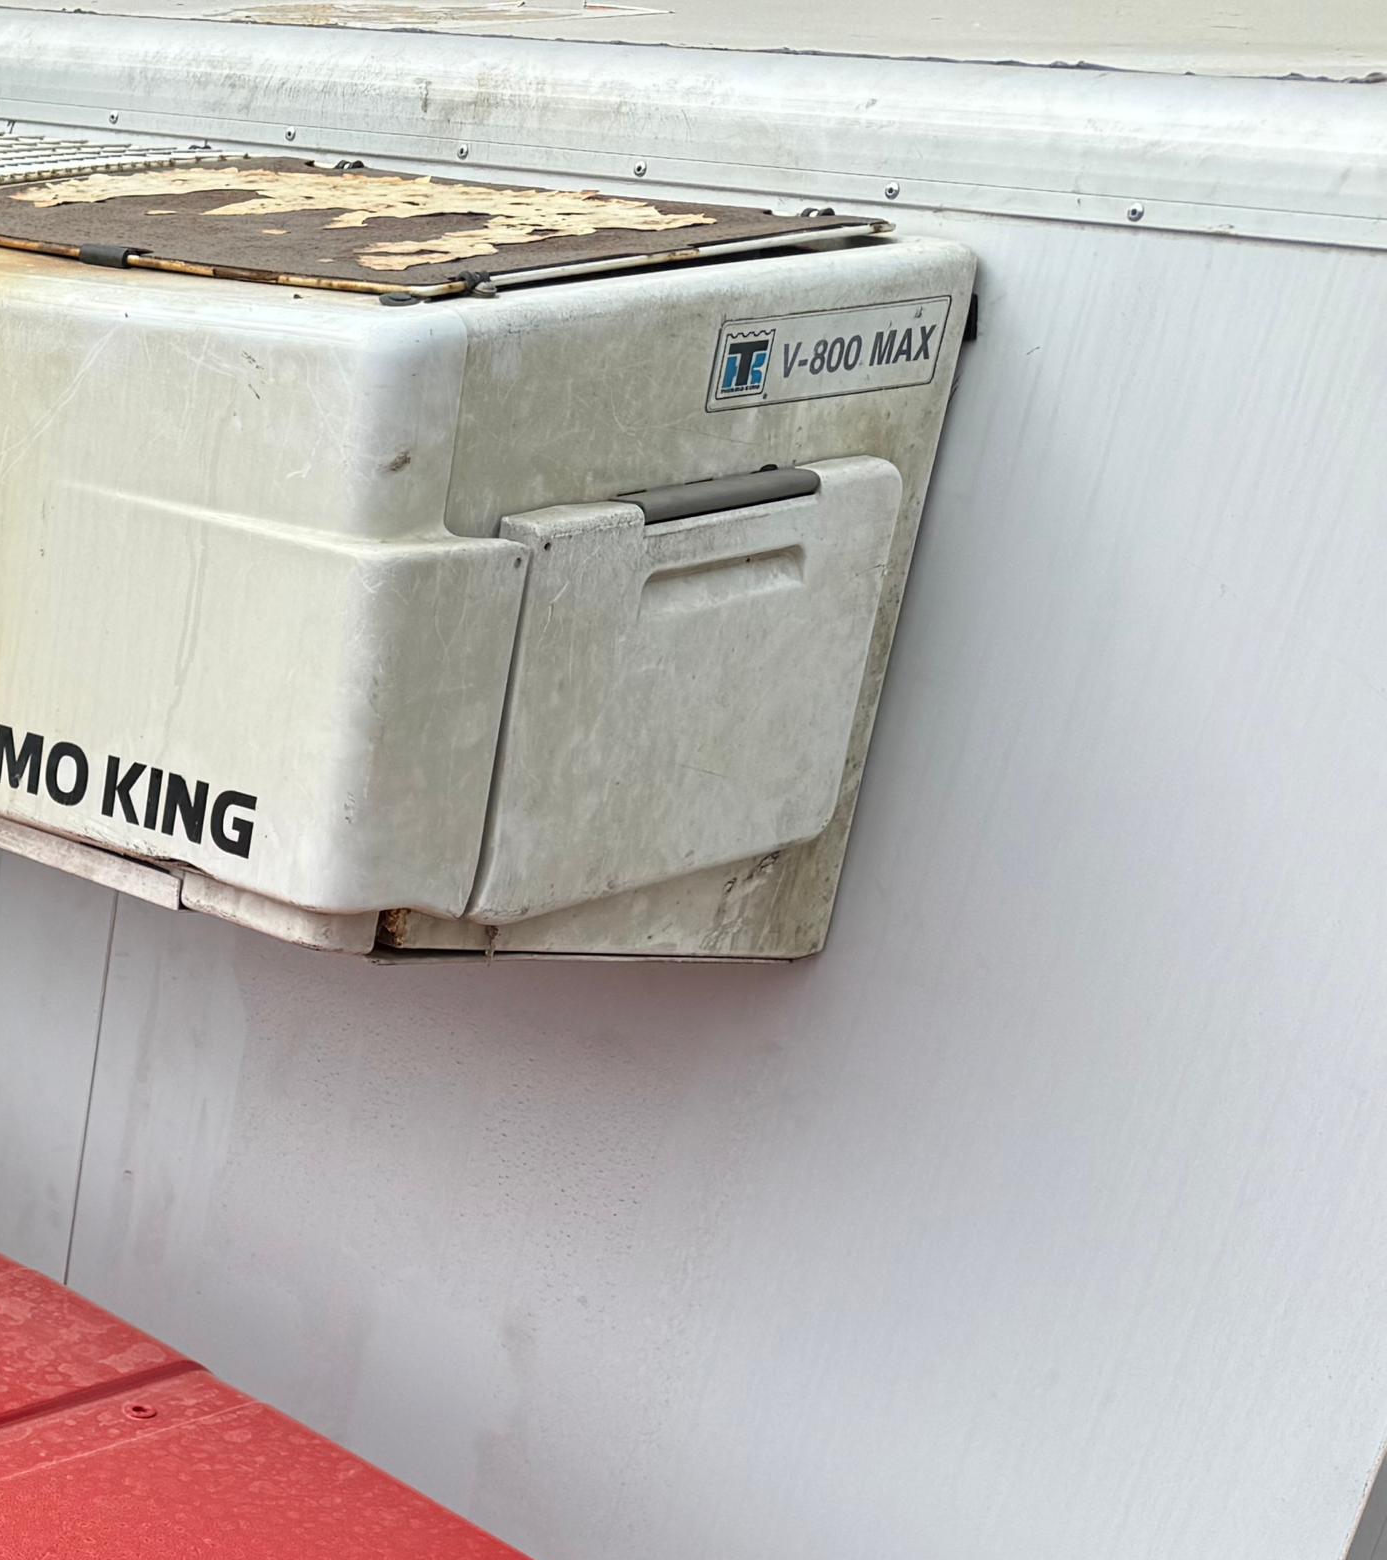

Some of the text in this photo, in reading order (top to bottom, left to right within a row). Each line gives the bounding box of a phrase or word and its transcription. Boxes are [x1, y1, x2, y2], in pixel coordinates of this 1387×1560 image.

[783, 324, 937, 378] V-800 MAX
[101, 755, 258, 859] KING
